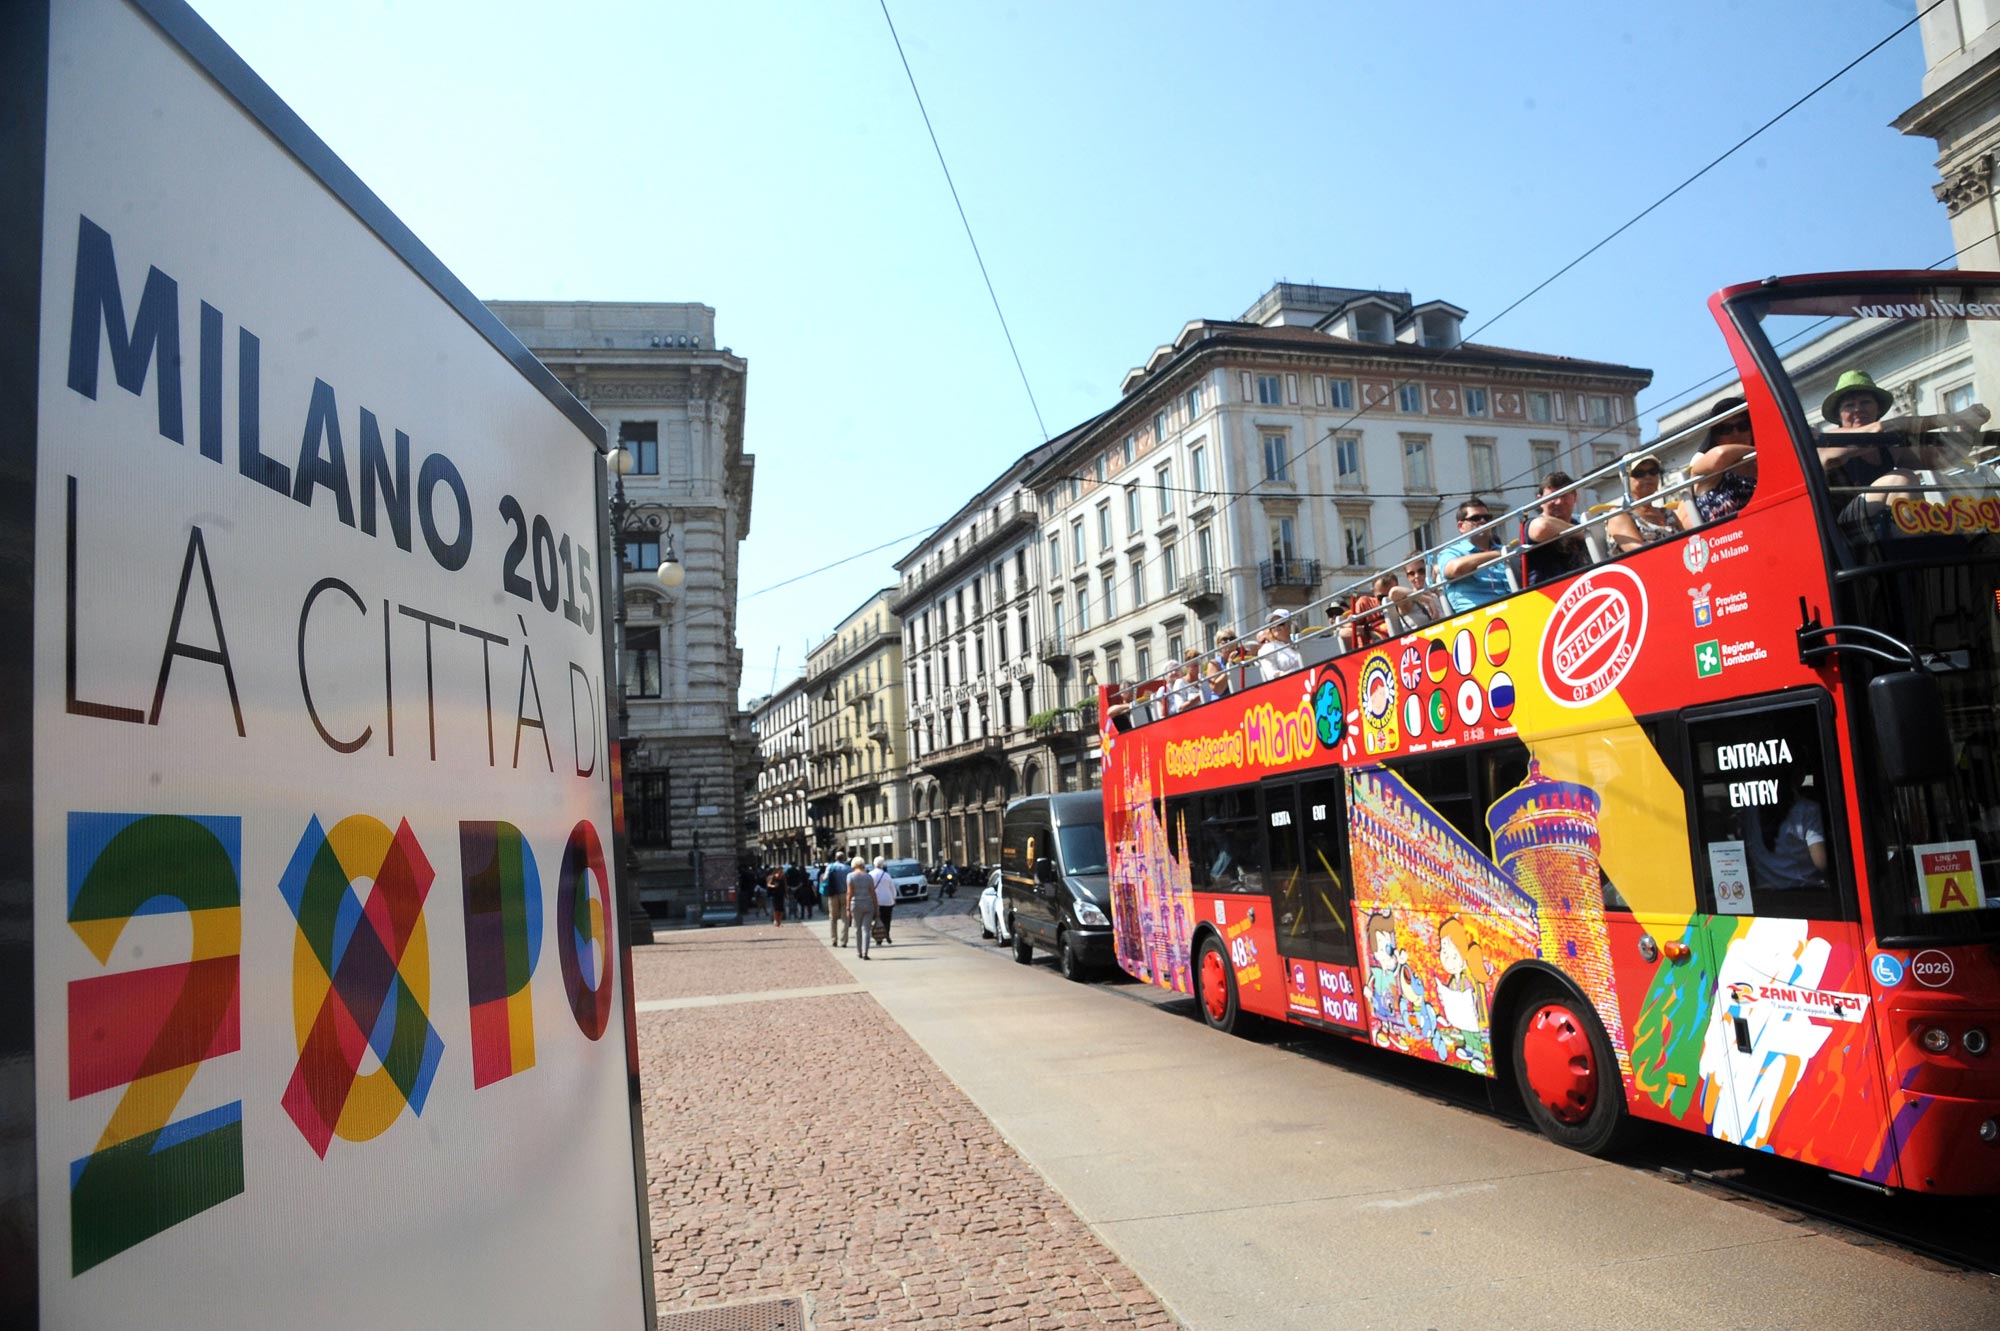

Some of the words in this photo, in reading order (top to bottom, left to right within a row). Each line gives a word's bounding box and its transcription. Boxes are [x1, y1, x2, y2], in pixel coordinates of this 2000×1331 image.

[67, 213, 473, 571] MILANO
[499, 494, 595, 636] 2015
[1709, 530, 1743, 548] Comune
[1710, 552, 1720, 564] di
[1720, 543, 1749, 560] Milano
[1560, 579, 1594, 616] TOUR
[1715, 591, 1747, 607] Provincia
[1717, 606, 1725, 617] di
[1725, 601, 1748, 615] Milano
[66, 474, 246, 738] LA
[298, 577, 554, 774] CITTÀ
[569, 661, 605, 782] DI
[1557, 599, 1626, 672] OFFICIAL
[1721, 640, 1755, 656] Regione
[1723, 648, 1767, 667] Lombardia
[1572, 685, 1588, 701] OF
[1591, 643, 1632, 696] MILANO
[1244, 700, 1317, 768] Milano
[1717, 738, 1793, 771] ENTRATA
[1729, 779, 1779, 808] ENTRY
[1934, 853, 1958, 862] LINEA
[1934, 863, 1960, 872] ROUTE
[1940, 877, 1969, 909] A
[1319, 969, 1339, 994] Hop
[1916, 963, 1950, 975] 2026
[1322, 995, 1342, 1020] Hop
[1342, 998, 1358, 1022] Off
[1759, 986, 1797, 1003] ZANI
[1801, 990, 1861, 1011] VIAGGI
